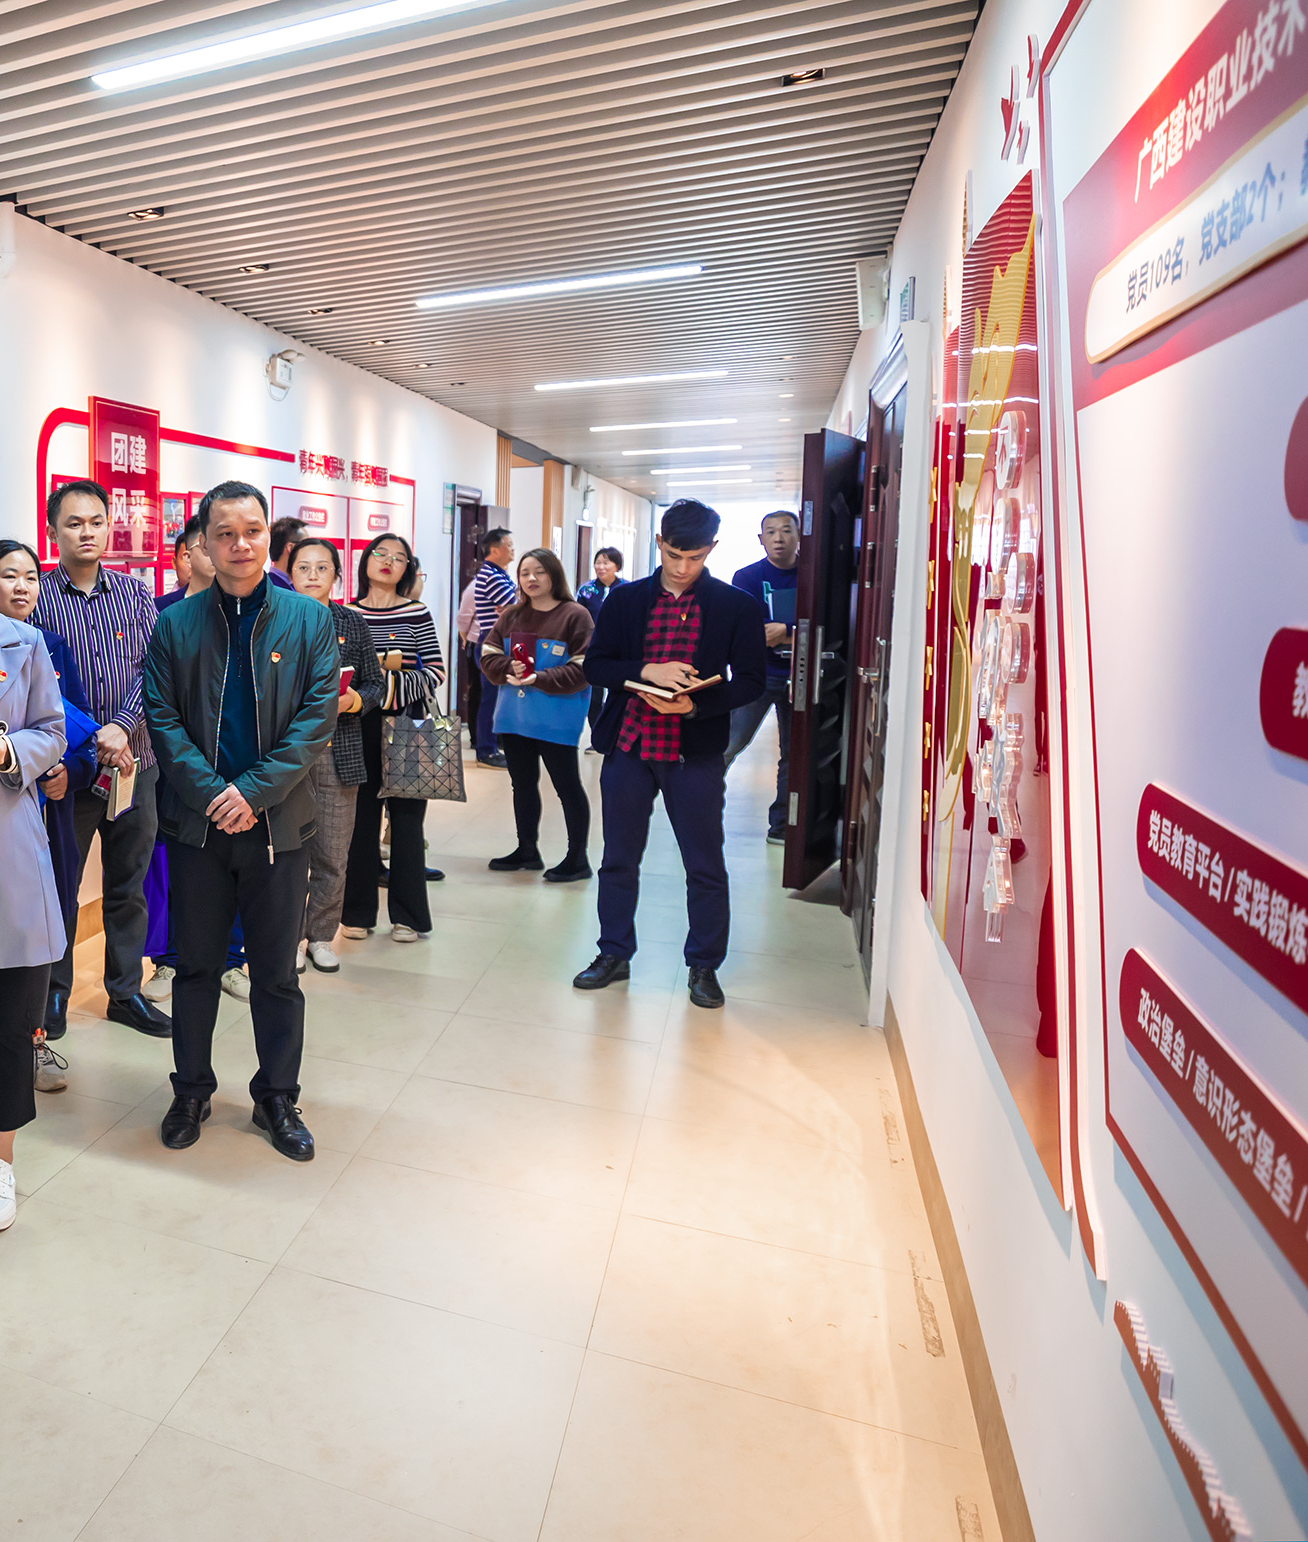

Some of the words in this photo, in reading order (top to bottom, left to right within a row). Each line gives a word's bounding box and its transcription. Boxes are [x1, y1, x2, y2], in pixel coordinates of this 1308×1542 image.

[1126, 134, 1308, 313] 党员109名，党支部2个；
[111, 431, 147, 475] 团建
[111, 487, 147, 528] 风采
